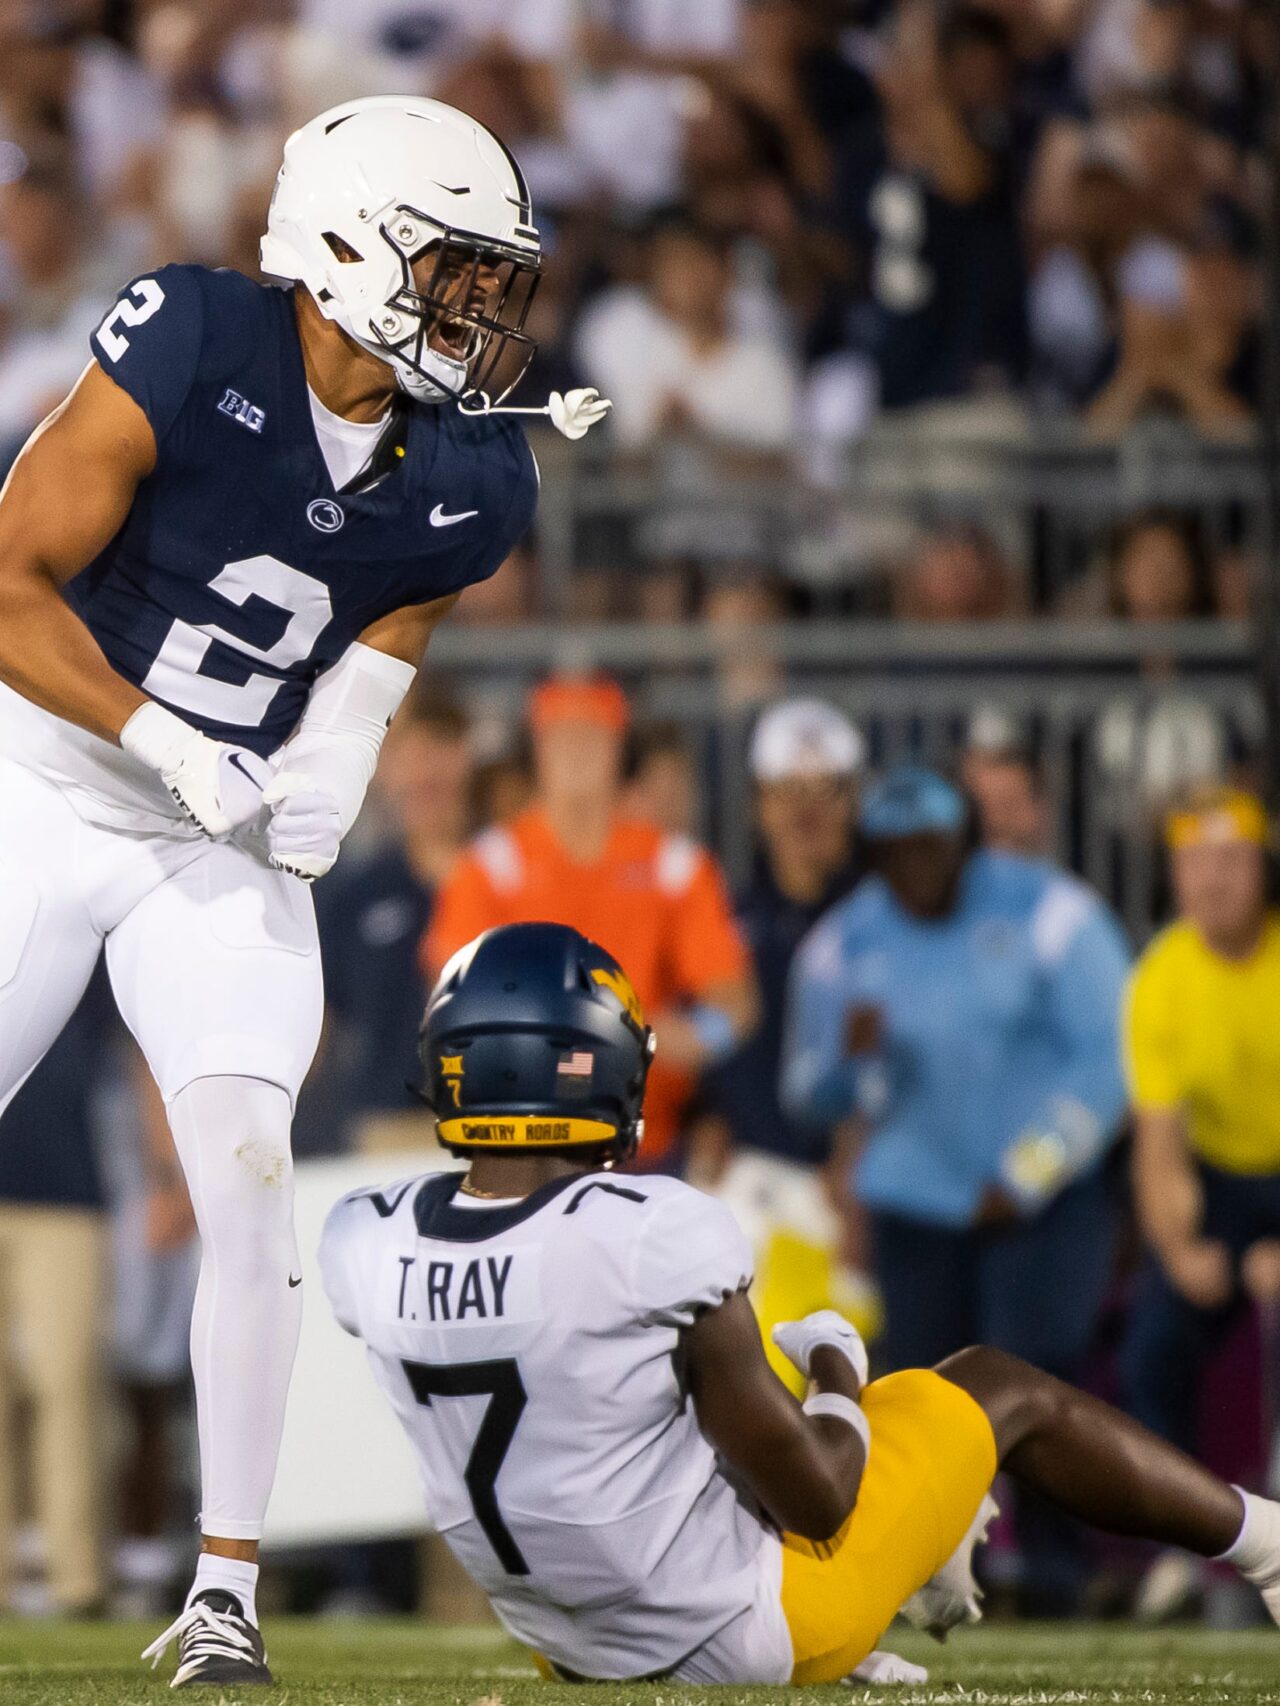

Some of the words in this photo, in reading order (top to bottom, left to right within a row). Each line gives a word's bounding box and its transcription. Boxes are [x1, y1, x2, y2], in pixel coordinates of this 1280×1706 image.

[96, 279, 166, 364] 2
[141, 554, 333, 727] 2
[447, 1079, 461, 1108] 7
[526, 1122, 570, 1140] ROADS
[400, 1358, 528, 1575] 7
